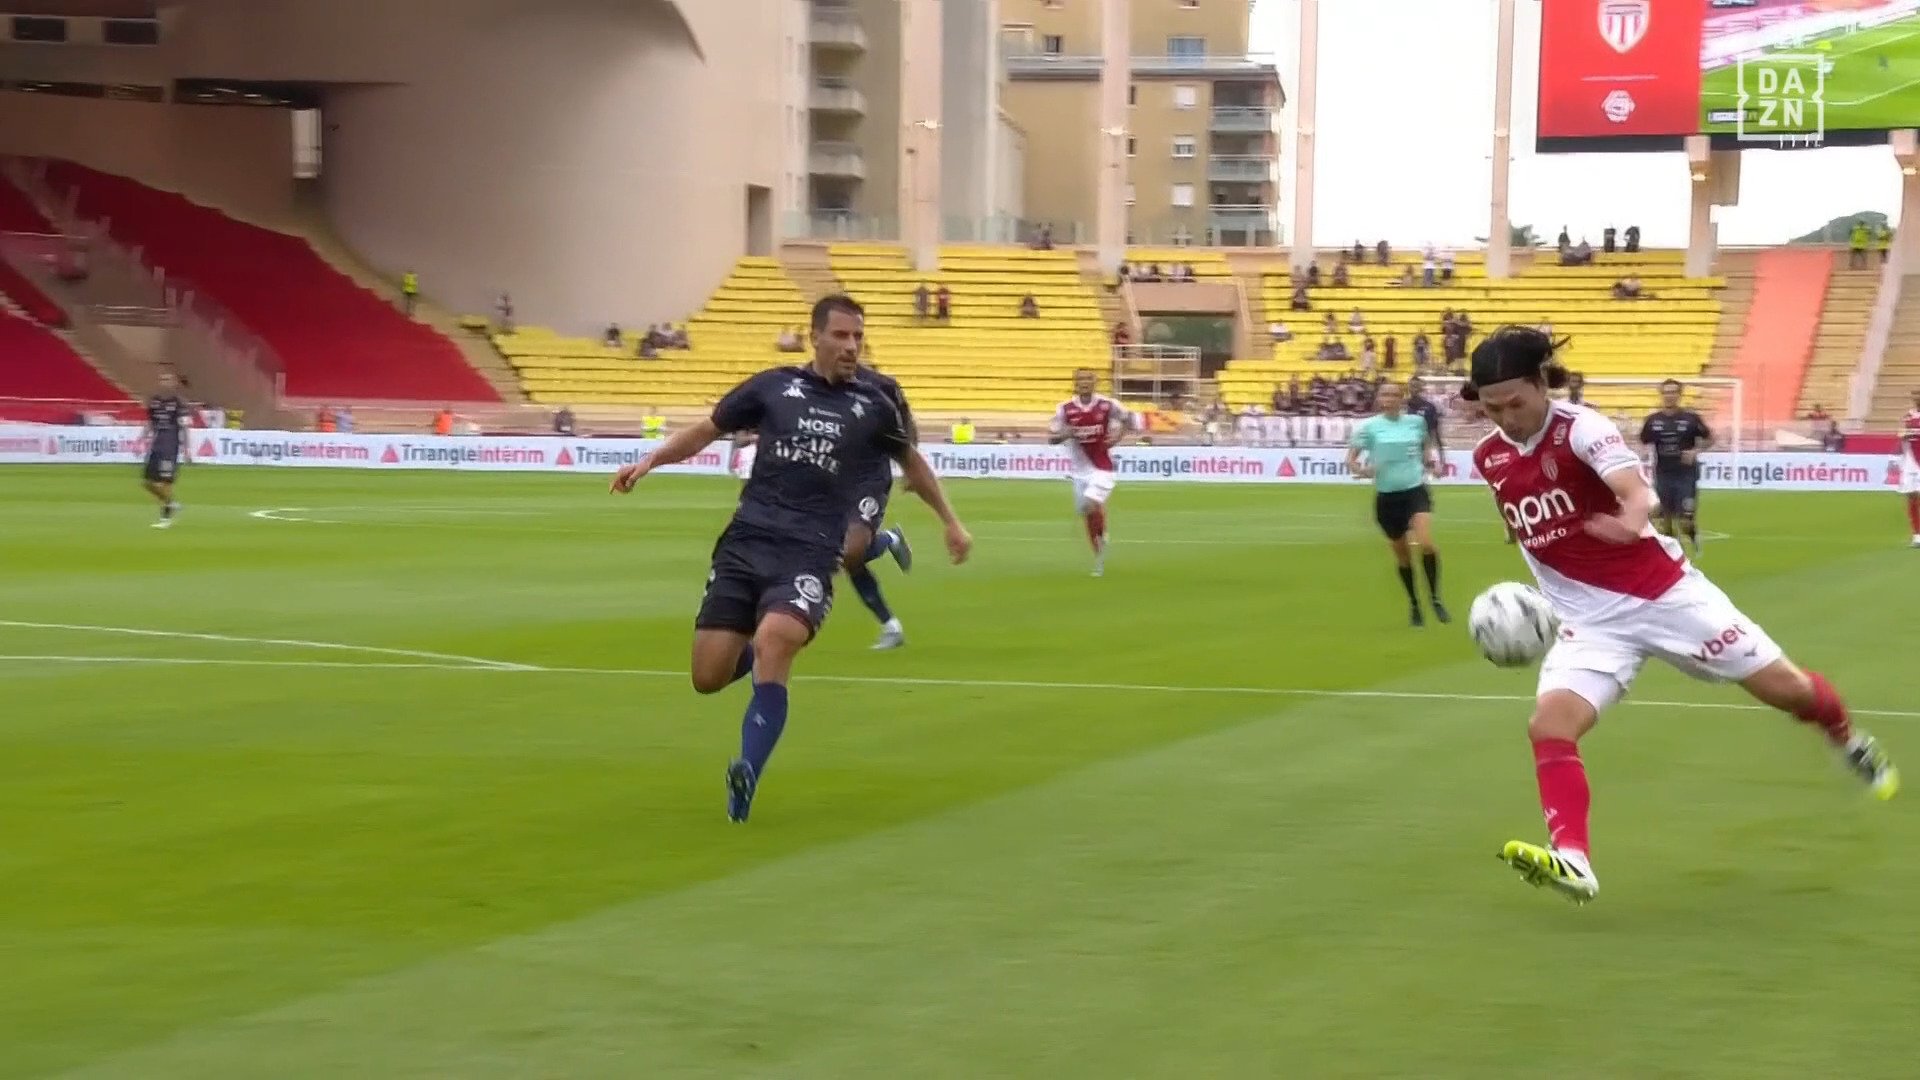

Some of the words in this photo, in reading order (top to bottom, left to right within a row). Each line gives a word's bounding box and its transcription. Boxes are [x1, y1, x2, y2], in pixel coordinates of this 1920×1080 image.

[1503, 487, 1576, 537] apm
[1523, 527, 1567, 548] MONACO
[1691, 623, 1747, 662] vbet
